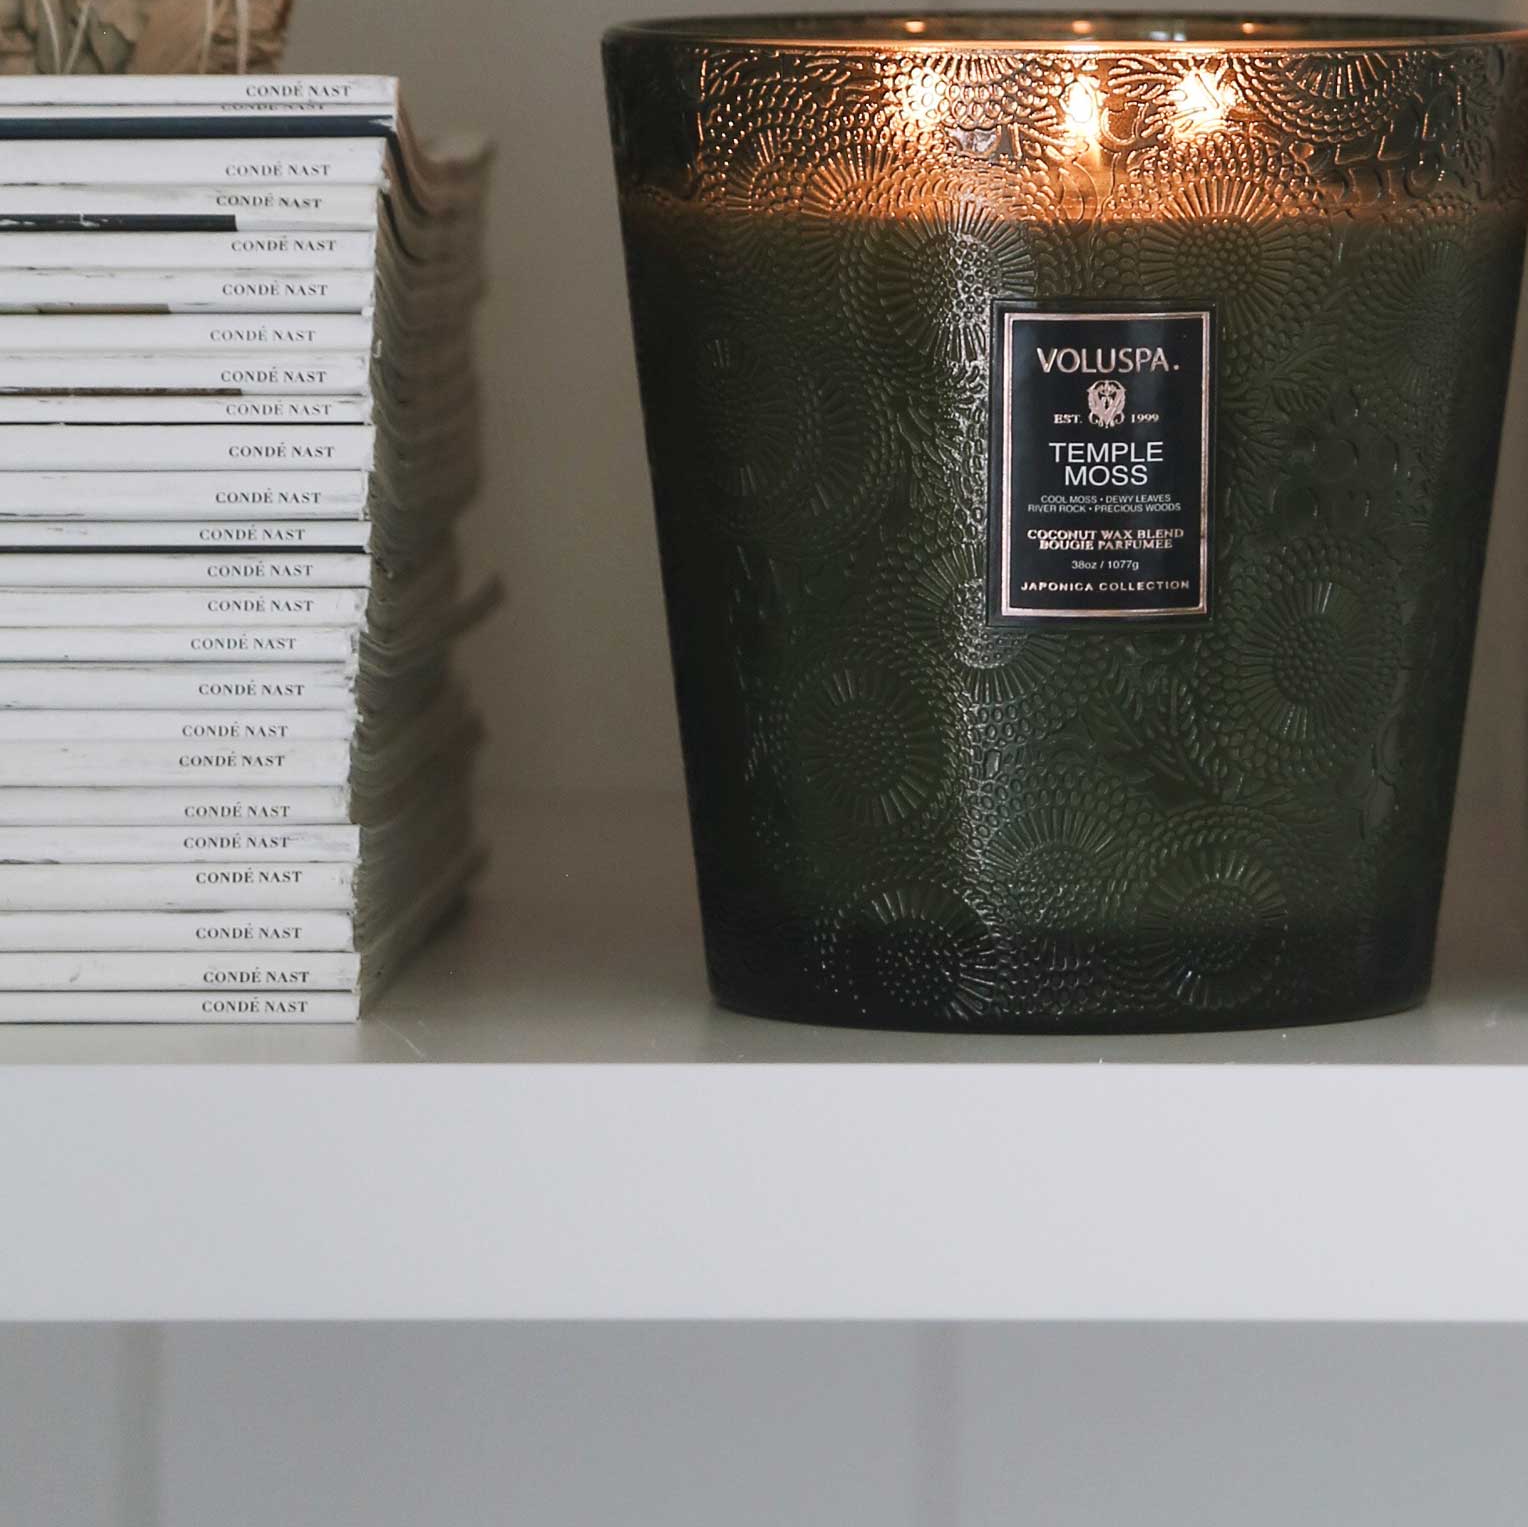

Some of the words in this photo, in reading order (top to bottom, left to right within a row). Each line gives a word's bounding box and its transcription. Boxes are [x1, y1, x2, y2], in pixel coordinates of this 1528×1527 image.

[246, 81, 303, 96] CONDÉ
[308, 86, 352, 96] NAST
[226, 160, 283, 175] CONDÉ
[288, 165, 331, 175] NAST
[216, 193, 273, 208] CONDÉ
[278, 198, 323, 208] NAST
[231, 236, 288, 250] CONDÉ
[293, 241, 337, 250] NAST
[222, 280, 279, 295] CONDÉ
[284, 285, 328, 295] NAST
[210, 326, 267, 341] CONDÉ
[272, 331, 316, 341] NAST
[221, 367, 278, 382] CONDÉ
[283, 372, 327, 382] NAST
[227, 400, 284, 414] CONDÉ
[289, 405, 332, 414] NAST
[1053, 413, 1082, 424] EST.
[1131, 413, 1160, 424] 1999
[229, 442, 286, 457] CONDÉ
[291, 447, 336, 457] NAST
[1048, 441, 1164, 463] TEMPLE
[1065, 464, 1148, 487] MOSS
[216, 488, 273, 503] CONDÉ
[278, 493, 322, 503] NAST
[1040, 495, 1067, 504] COOL
[1069, 495, 1098, 504] MOSS
[1105, 495, 1134, 504] DEWY
[1135, 494, 1171, 503] LEAVES
[1027, 504, 1057, 513] RIVER
[1058, 504, 1086, 513] ROCK
[1094, 504, 1144, 513] PRECIOUS
[1145, 502, 1181, 512] WOODS
[200, 524, 257, 540] CONDÉ
[262, 529, 306, 540] NAST
[1027, 529, 1096, 540] COCONUT
[1100, 529, 1133, 540] WAX
[1137, 528, 1184, 539] BLEND
[1039, 539, 1094, 550] BOUGIE
[207, 560, 264, 576] CONDÉ
[269, 565, 314, 576] NAST
[1071, 560, 1097, 570] 38oz
[1107, 559, 1140, 571] 1077g
[1020, 581, 1094, 592] JAPONICA
[1098, 580, 1189, 591] COLLECTION
[207, 595, 264, 611] CONDÉ
[269, 600, 314, 611] NAST
[191, 634, 248, 649] CONDÉ
[253, 639, 297, 649] NAST
[199, 680, 256, 695] CONDÉ
[261, 685, 305, 695] NAST
[182, 721, 239, 736] CONDÉ
[244, 726, 289, 736] NAST
[179, 751, 236, 766] CONDÉ
[241, 756, 286, 766] NAST
[184, 801, 241, 817] CONDÉ
[246, 806, 291, 817] NAST
[184, 832, 241, 848] CONDÉ
[246, 837, 290, 848] NAST
[196, 867, 253, 882] CONDÉ
[258, 872, 303, 882] NAST
[196, 923, 253, 938] CONDÉ
[258, 928, 303, 938] NAST
[203, 967, 260, 982] CONDÉ
[265, 972, 310, 982] NAST
[202, 997, 259, 1012] CONDÉ
[264, 1002, 309, 1012] NAST
